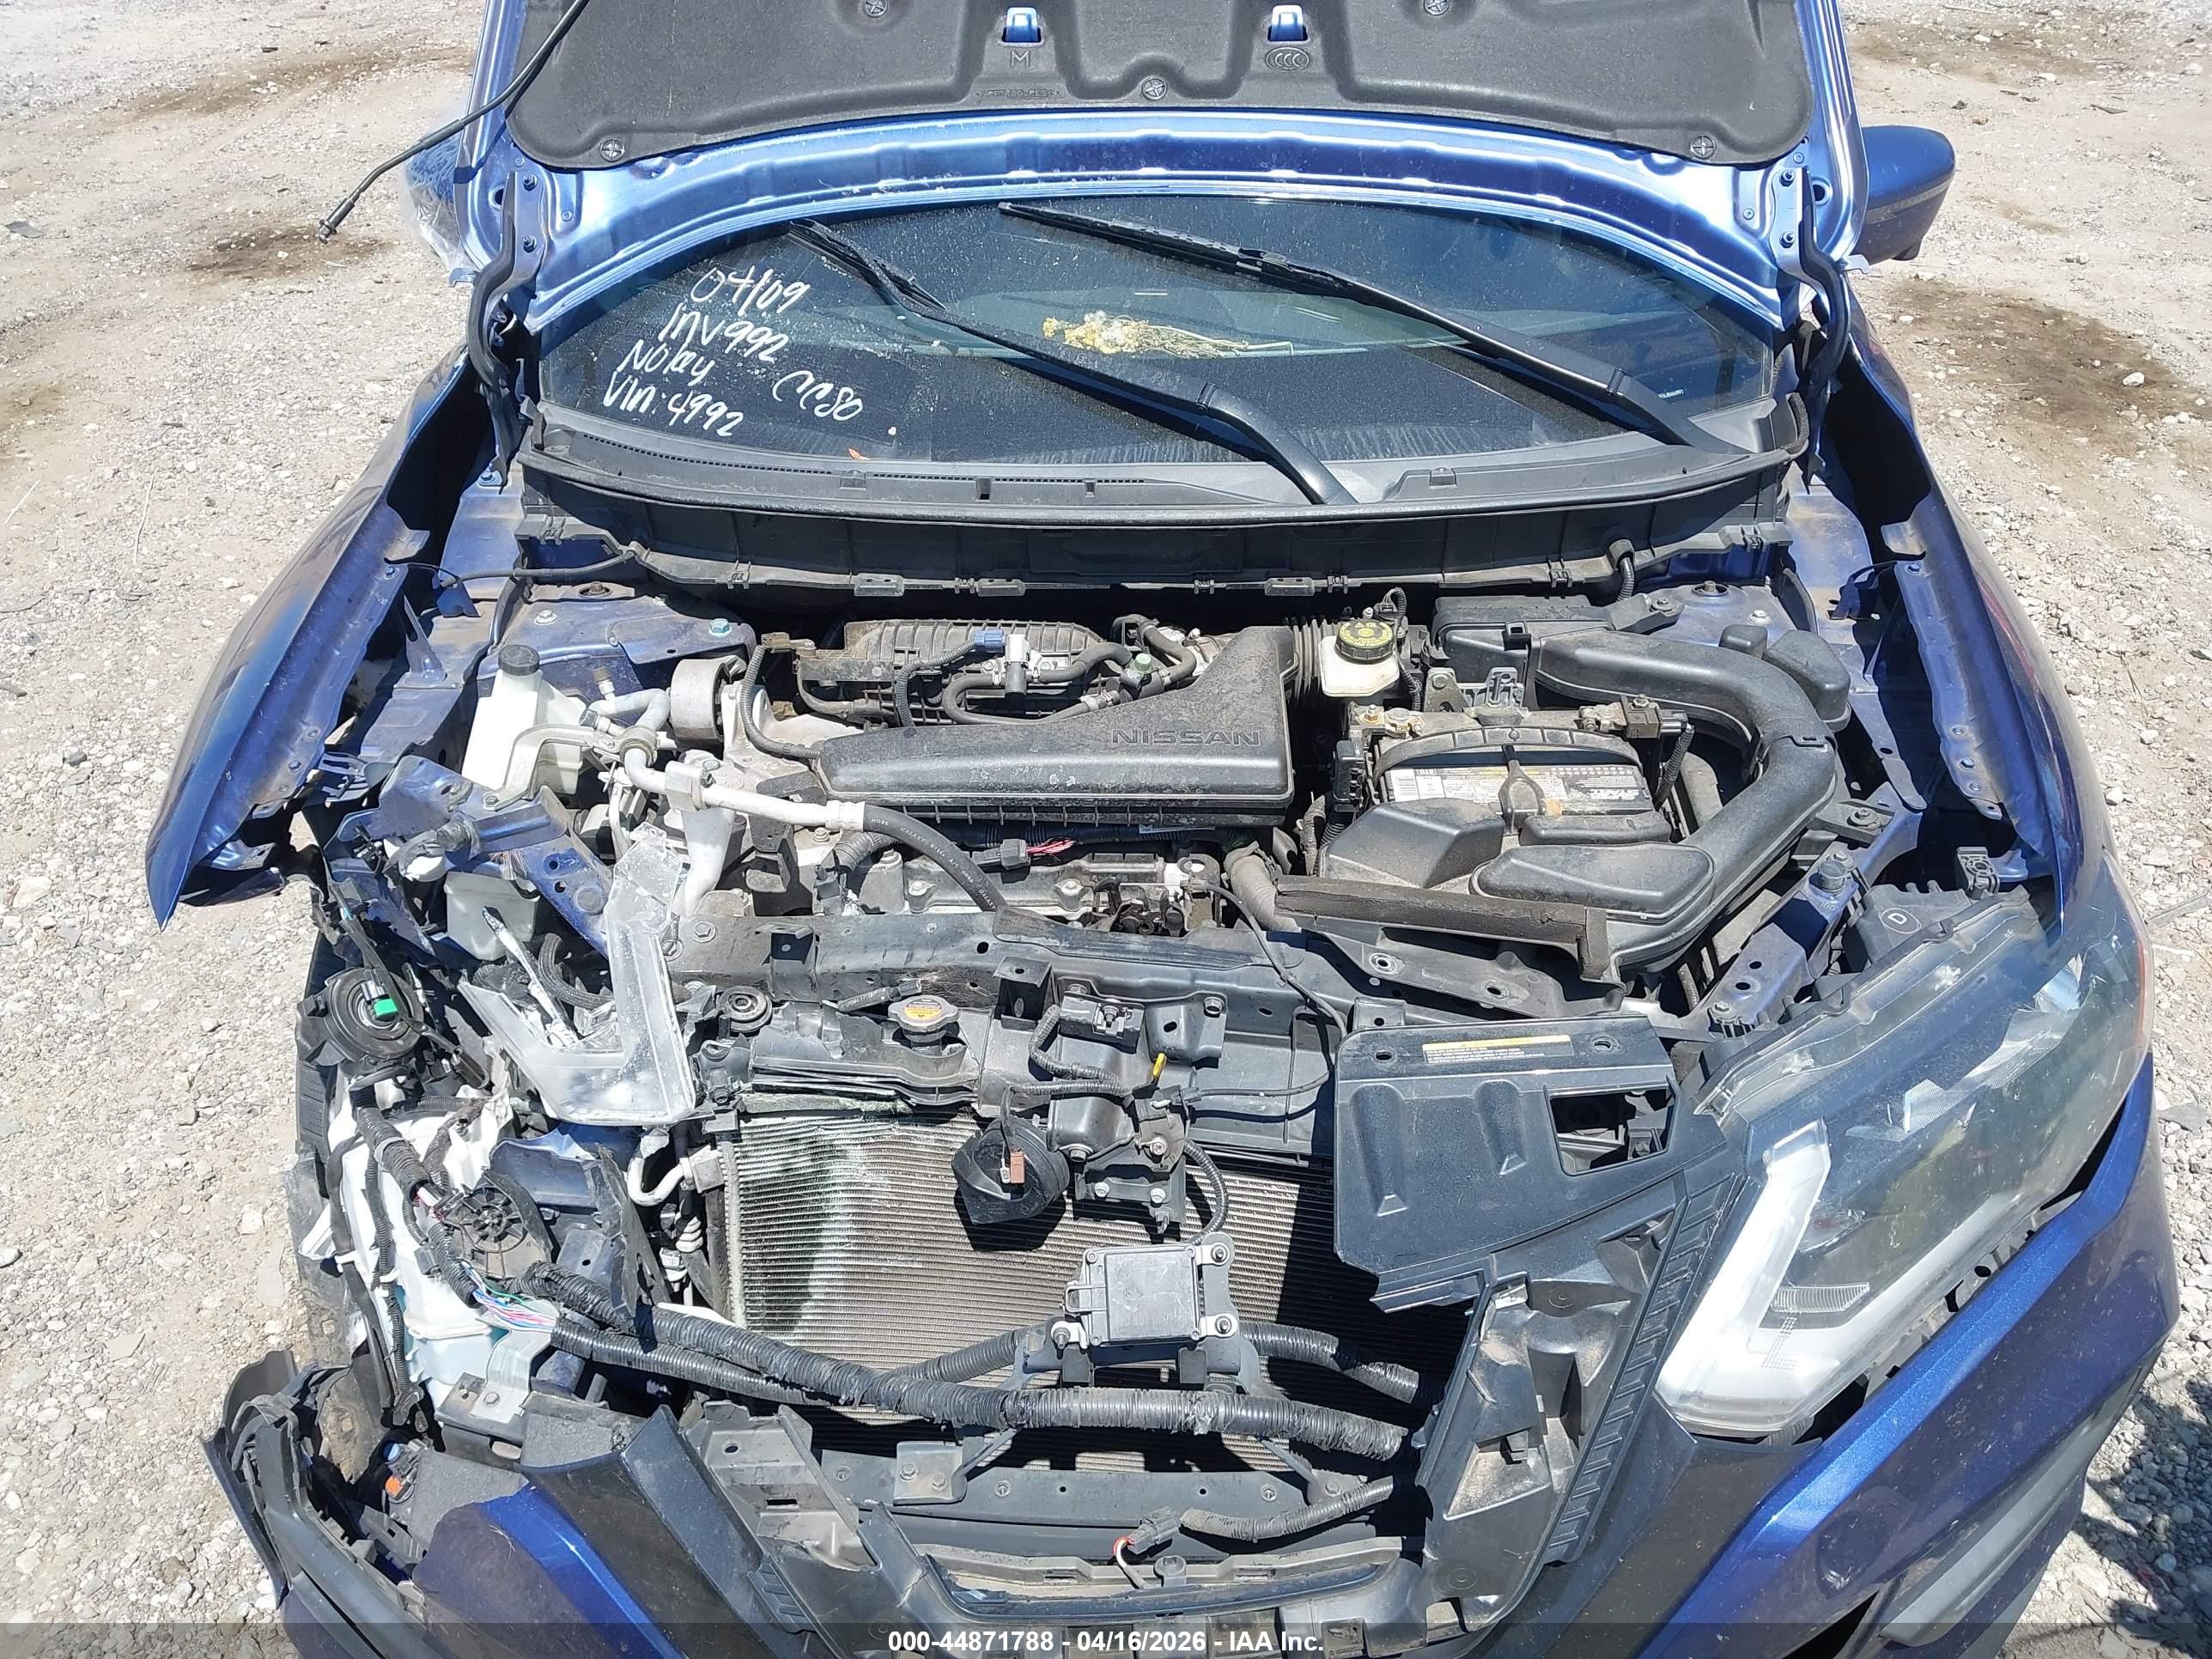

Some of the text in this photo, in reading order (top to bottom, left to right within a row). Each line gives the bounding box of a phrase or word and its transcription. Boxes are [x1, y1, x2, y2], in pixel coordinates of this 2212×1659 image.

[1010, 50, 1030, 68] M
[1111, 728, 1261, 747] NISSAN
[1888, 913, 1907, 924] D
